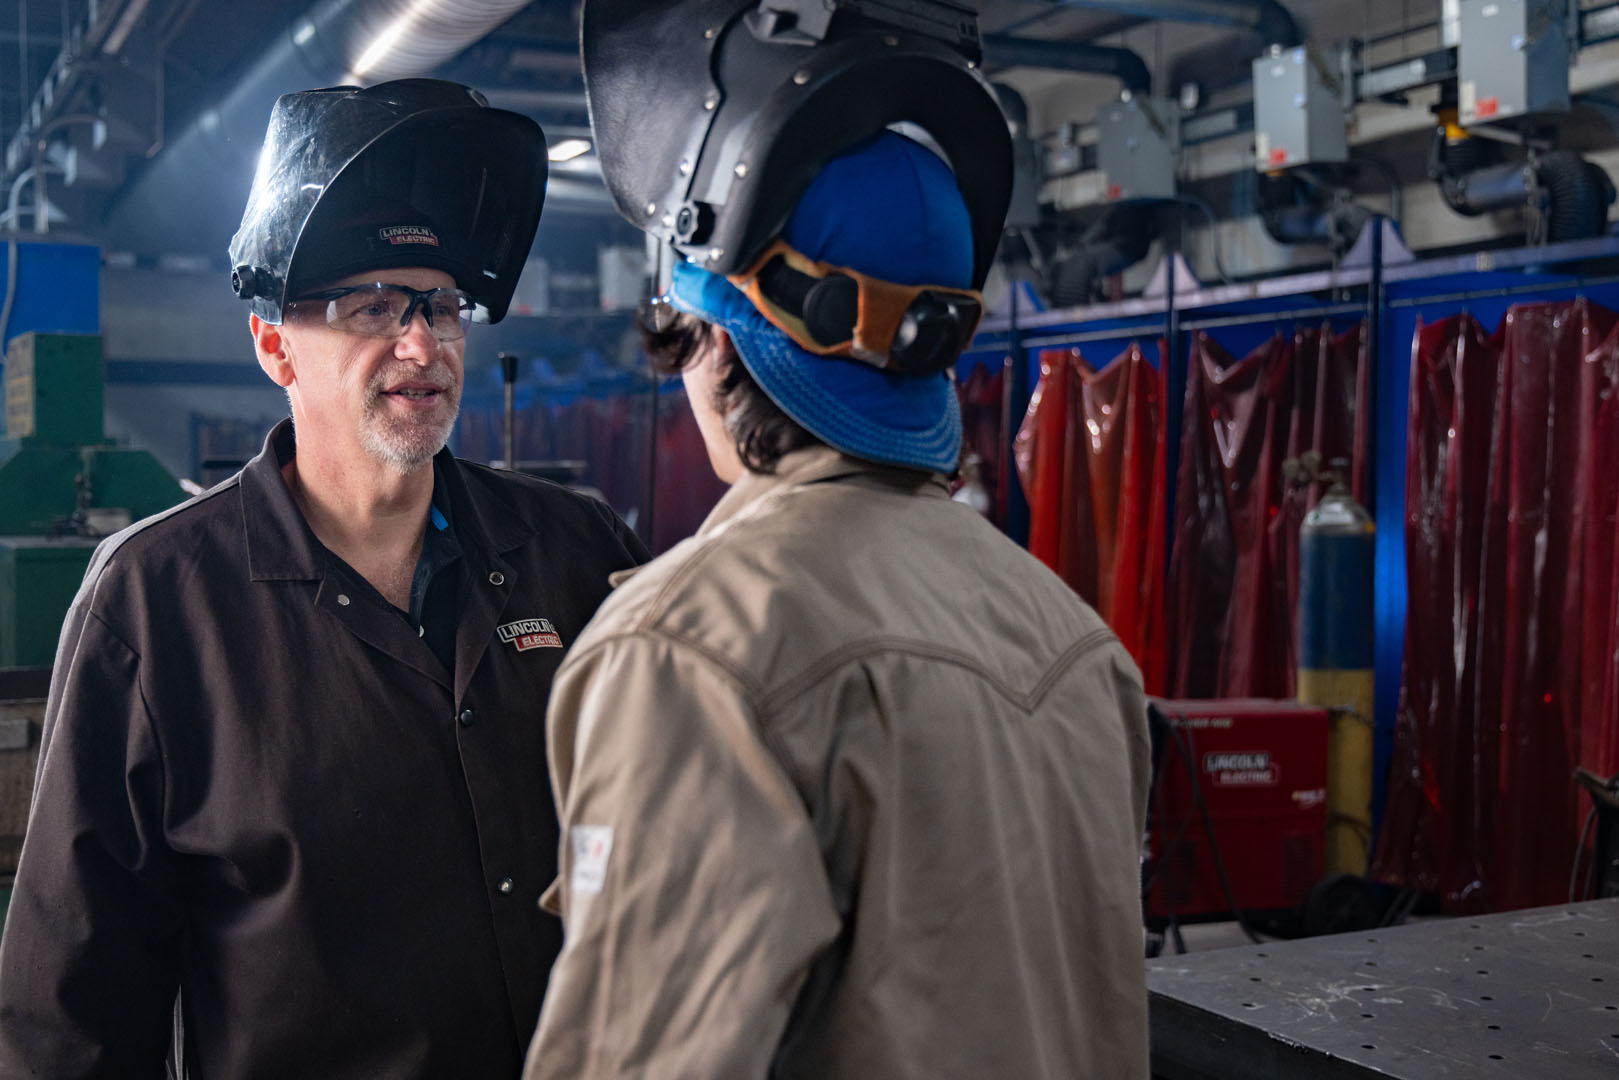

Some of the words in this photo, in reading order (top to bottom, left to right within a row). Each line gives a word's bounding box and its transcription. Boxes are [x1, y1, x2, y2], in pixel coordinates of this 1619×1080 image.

[383, 227, 429, 237] LINCOLN
[396, 235, 435, 244] ELECTRIC
[501, 620, 551, 638] LINCOLN
[521, 635, 559, 647] ELECTRIC
[1207, 754, 1268, 771] LINCOLN
